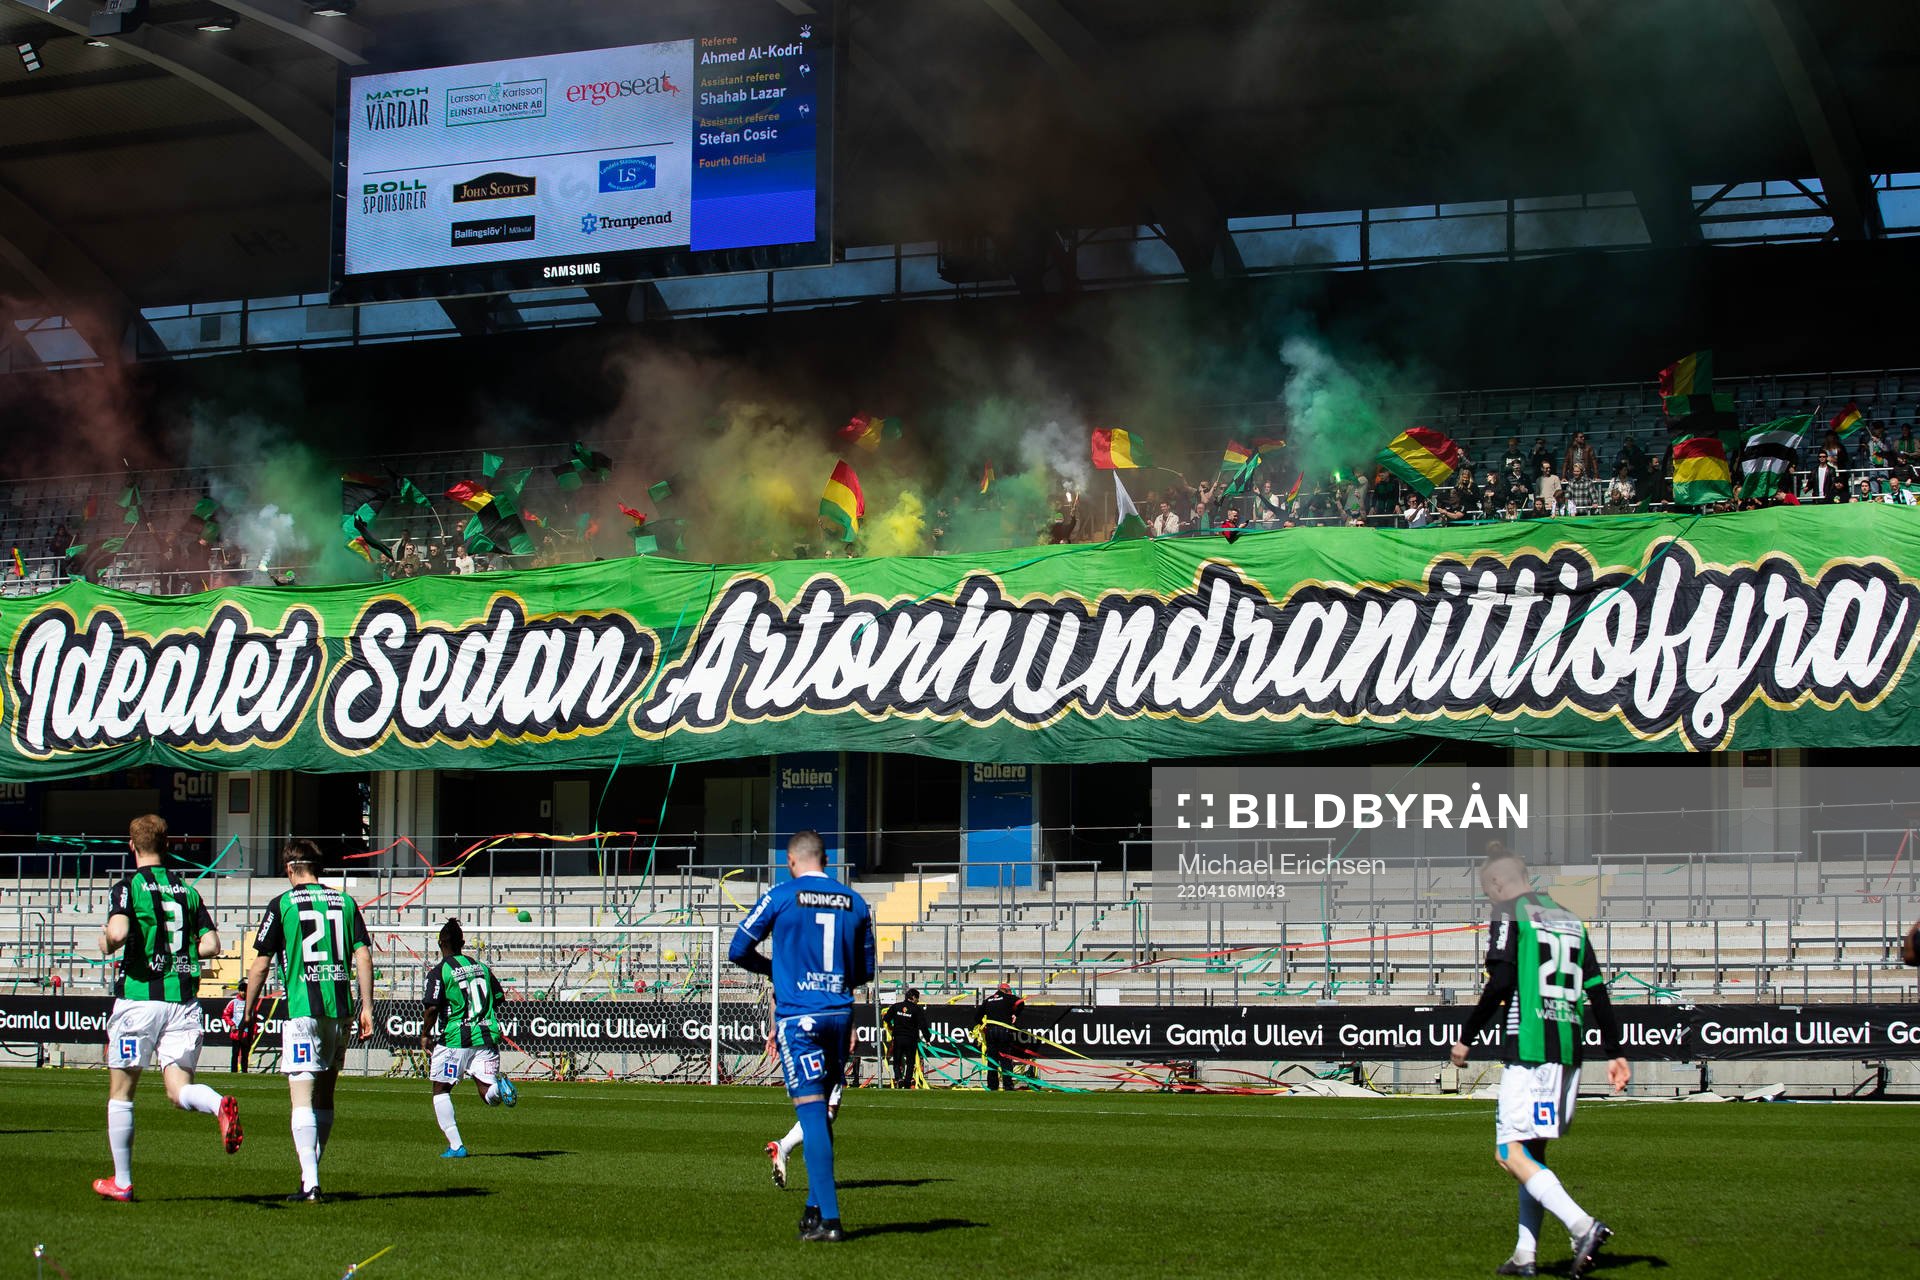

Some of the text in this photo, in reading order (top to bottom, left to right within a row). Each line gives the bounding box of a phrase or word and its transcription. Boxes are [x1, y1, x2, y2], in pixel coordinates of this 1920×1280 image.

[701, 36, 738, 47] Referee
[700, 42, 803, 65] Ahmed Al-Kodri
[566, 70, 674, 105] ergoseat
[700, 72, 781, 87] Assistant referee
[366, 86, 429, 101] MATCH
[450, 93, 487, 104] Larsson
[502, 87, 543, 98] Karlsson
[700, 87, 787, 105] Shahab Lazar
[366, 98, 429, 131] VÄRDAR
[530, 100, 543, 109] AB
[700, 113, 780, 127] Assistant referee
[699, 126, 778, 145] Stefan Cosic
[699, 153, 766, 168] Fourth Official
[363, 179, 427, 195] BOLL
[460, 185, 487, 199] JOHN
[363, 191, 427, 215] SPONSORER
[599, 210, 673, 229] Tranpenad
[455, 226, 500, 239] Ballingslöv
[543, 262, 601, 278] SAMSUNG
[21, 556, 1908, 750] Idealet Sedan Artonhundranittiofyra
[173, 771, 212, 801] Sofi
[799, 892, 851, 909] NIDINGEN
[299, 910, 344, 963] 21
[815, 912, 836, 973] 1
[307, 963, 345, 974] NORDIC
[1536, 929, 1584, 1003] 25
[0, 1009, 107, 1031] Gamla Ullevi
[530, 1016, 601, 1039] Gamla
[606, 1017, 667, 1040] Ullevi
[682, 1018, 754, 1042] Gamla
[1013, 1023, 1151, 1046] amla Ullevi
[1166, 1023, 1324, 1047] Gamla Ullevi
[1339, 1023, 1421, 1046] Gamla
[1700, 1020, 1788, 1045] Gamla
[1794, 1020, 1871, 1045] Ullevi
